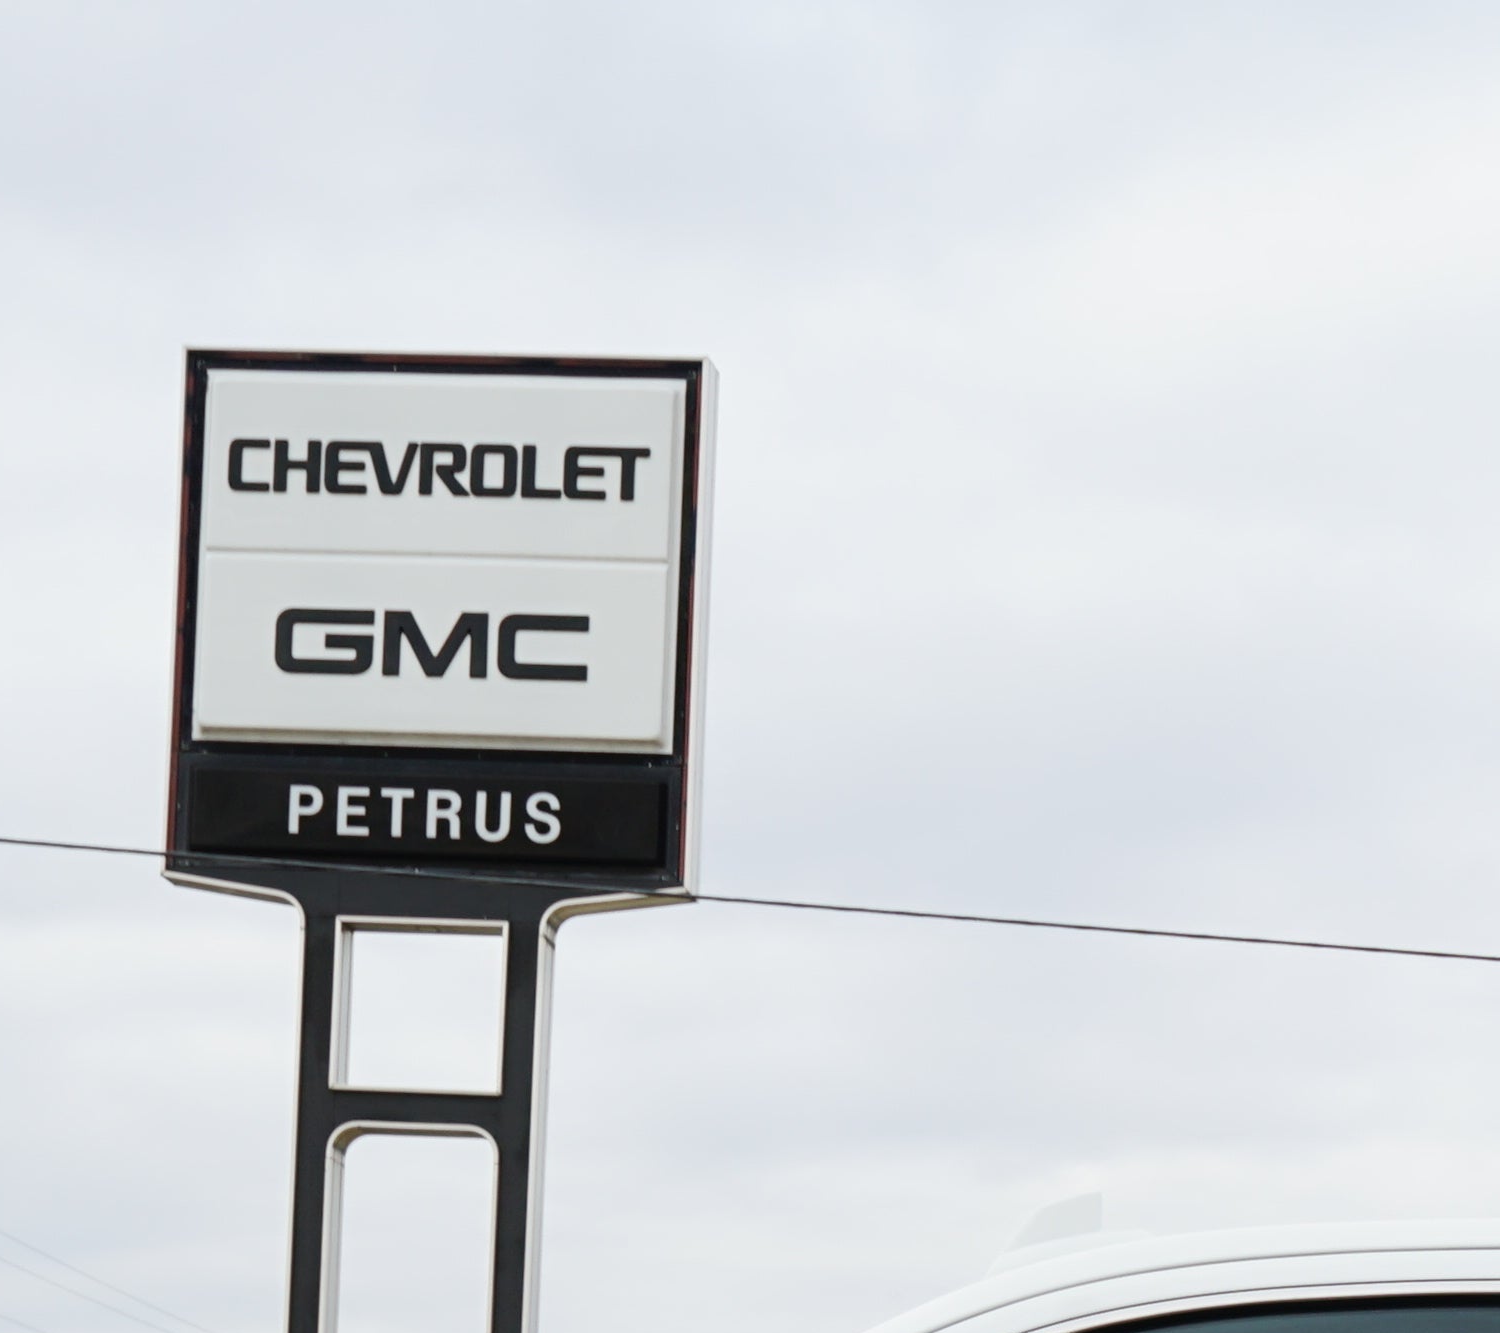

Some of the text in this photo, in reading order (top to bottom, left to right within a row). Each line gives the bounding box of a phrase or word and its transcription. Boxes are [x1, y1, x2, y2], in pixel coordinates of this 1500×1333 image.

[226, 437, 652, 502] CHEVROLET
[274, 607, 590, 683] GMC
[286, 783, 563, 845] PETRUS
